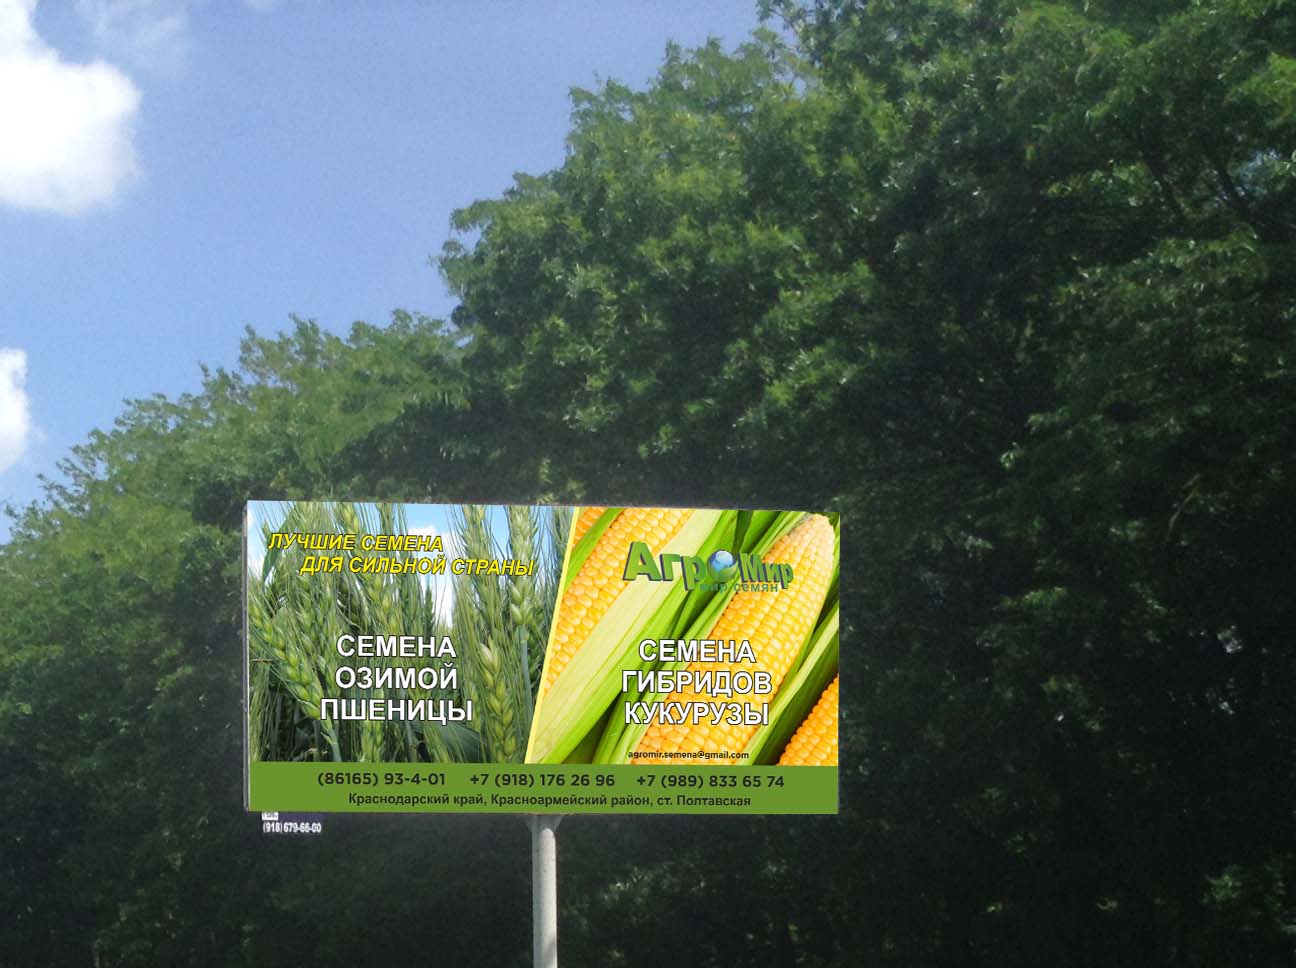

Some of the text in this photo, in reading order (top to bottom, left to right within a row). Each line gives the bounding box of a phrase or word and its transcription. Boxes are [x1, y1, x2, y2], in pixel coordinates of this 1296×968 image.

[268, 533, 444, 552] ЛУЧШИЕ СЕМЕНА
[300, 555, 535, 576] ДЛЯ СИЛЬНОЙ СТРАНЫ
[734, 582, 779, 593] семян
[336, 635, 457, 658] СЕМЕНА
[638, 639, 756, 663] СЕМЕНА
[335, 663, 458, 690] ОЗИМОЙ
[621, 670, 773, 698] ГИБРИДОВ
[319, 698, 473, 726] ПШЕНИЦЫ
[624, 702, 770, 726] КУКУРУЗЫ
[627, 751, 750, 760] agromir.semena@gmail.com
[317, 773, 785, 789] (86165) 93-4-01 +7 (918) 176 26 96 +7 (989) 833 65 74
[349, 793, 751, 807] Краснодарский край, Красноармейский район, ст. Полтавская
